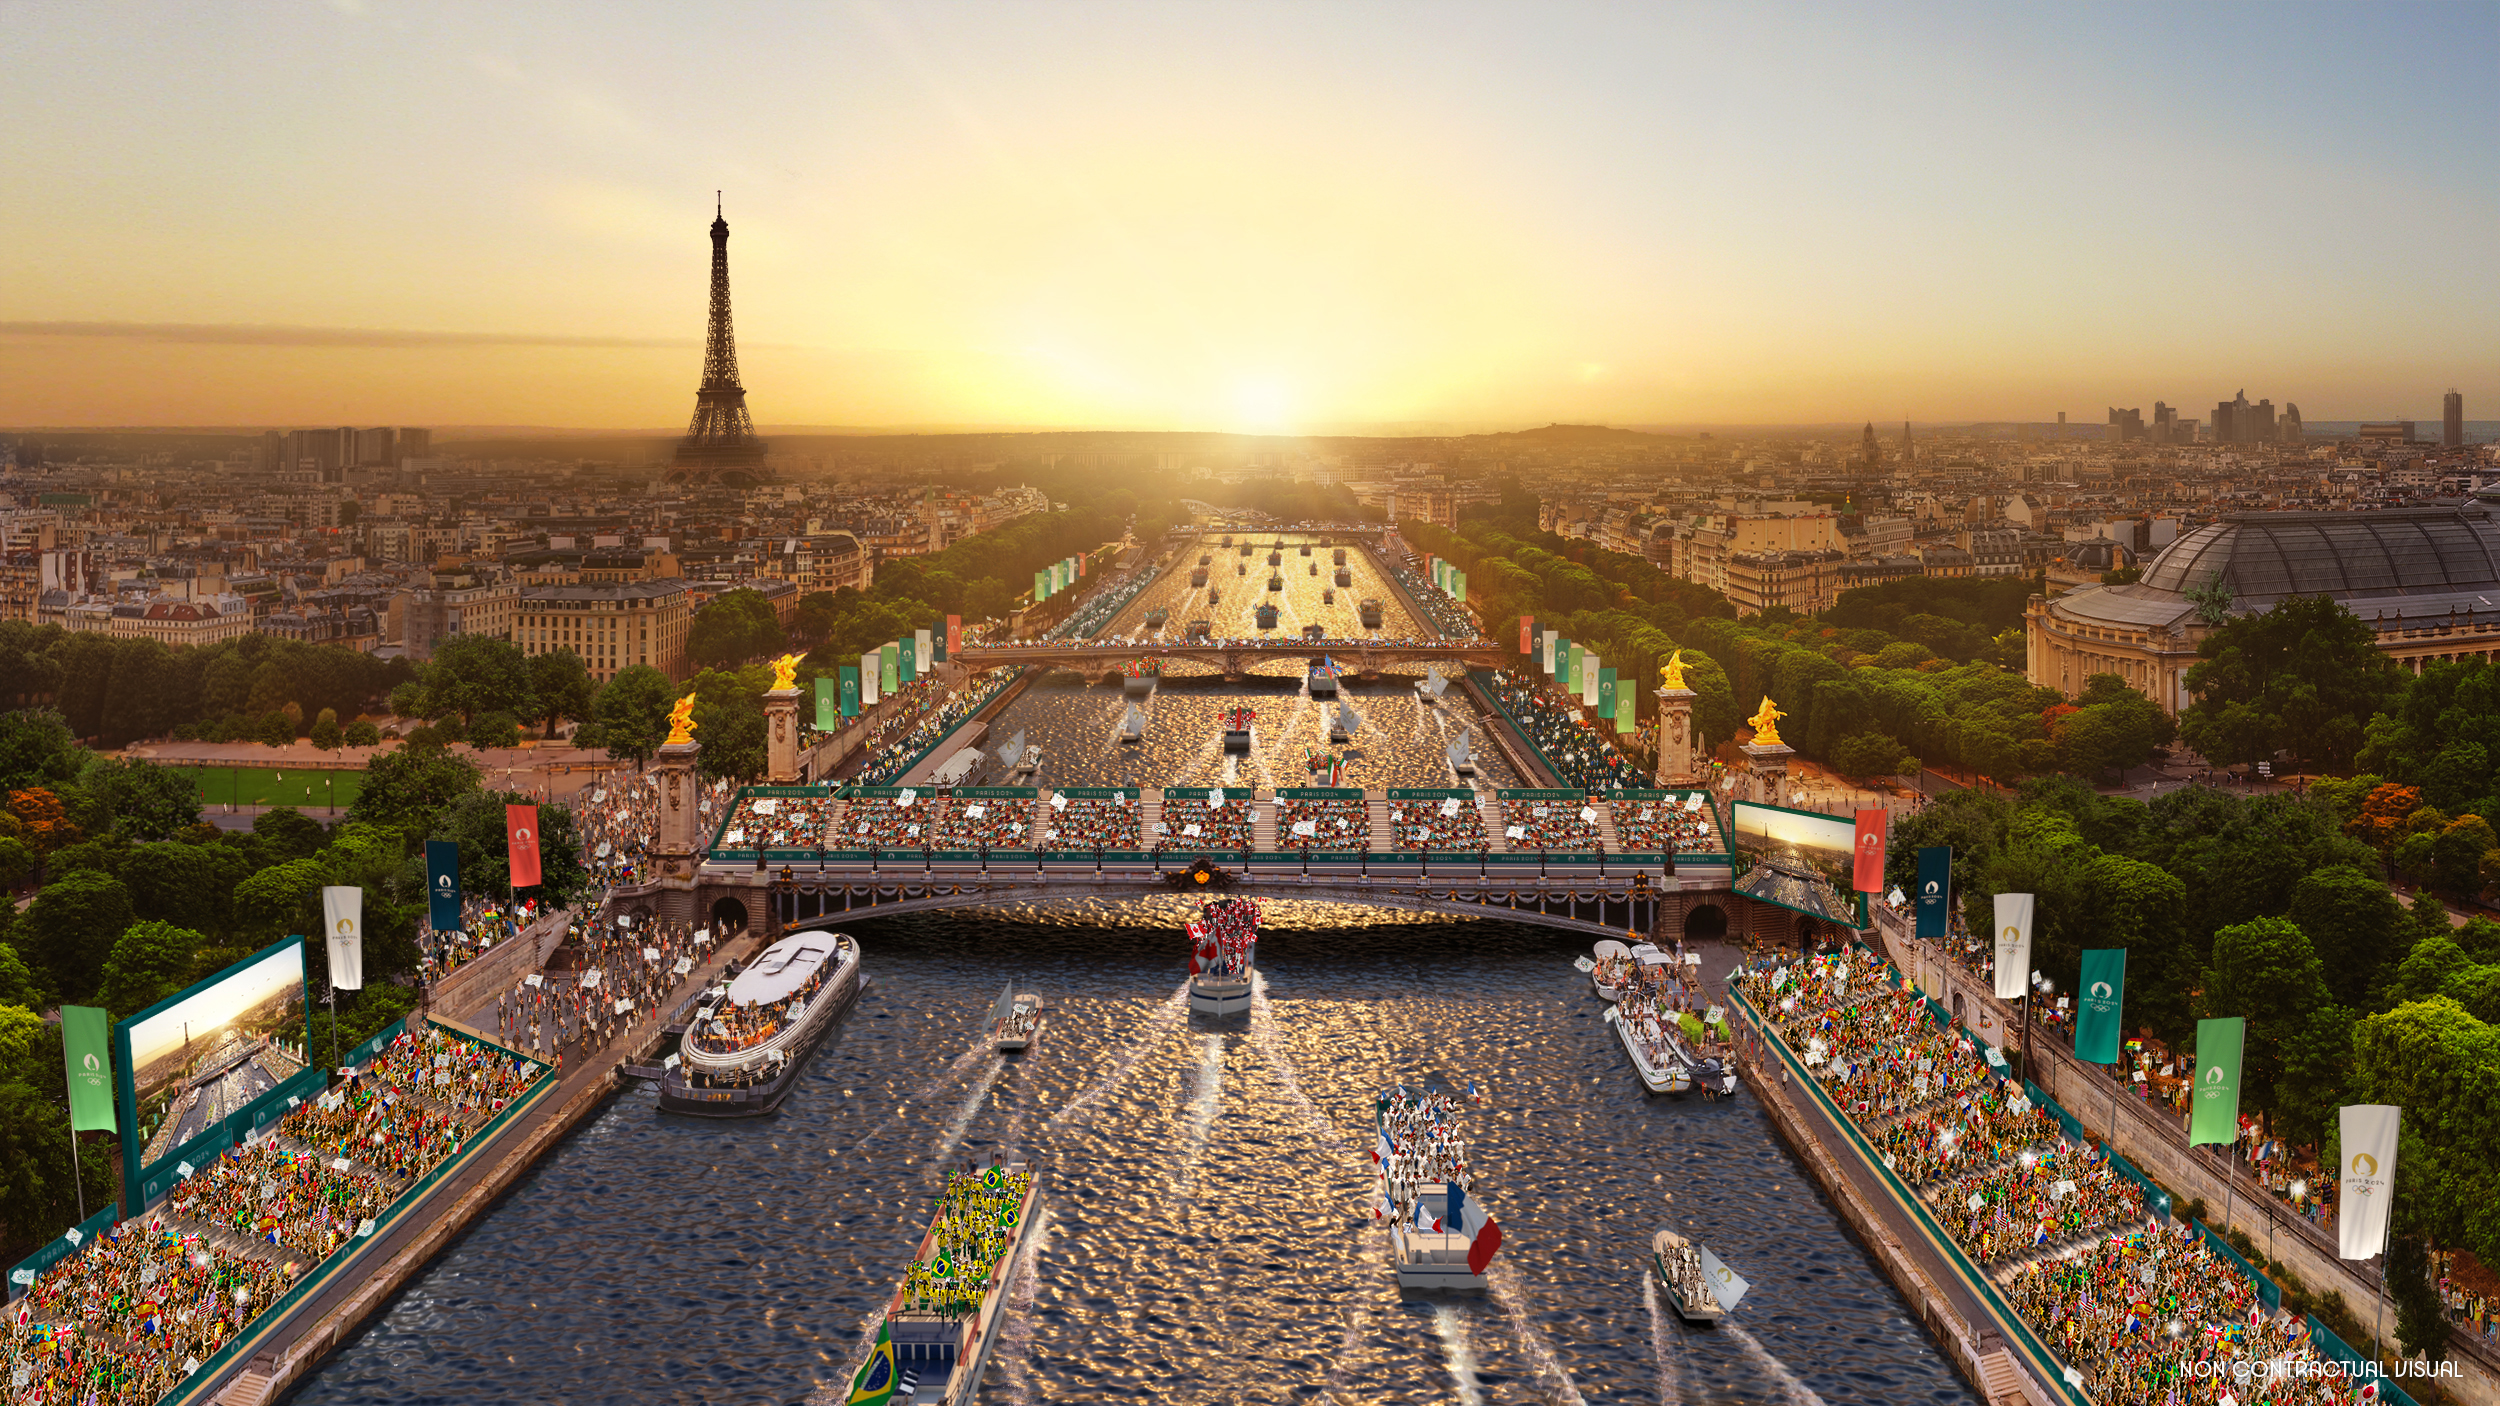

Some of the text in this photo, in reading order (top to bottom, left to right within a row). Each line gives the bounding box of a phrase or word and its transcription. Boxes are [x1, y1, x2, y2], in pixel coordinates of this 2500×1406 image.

[41, 1242, 66, 1264] PARIS
[258, 1286, 305, 1330] PARIS 2024
[1998, 1304, 2034, 1350] PARIS 2024
